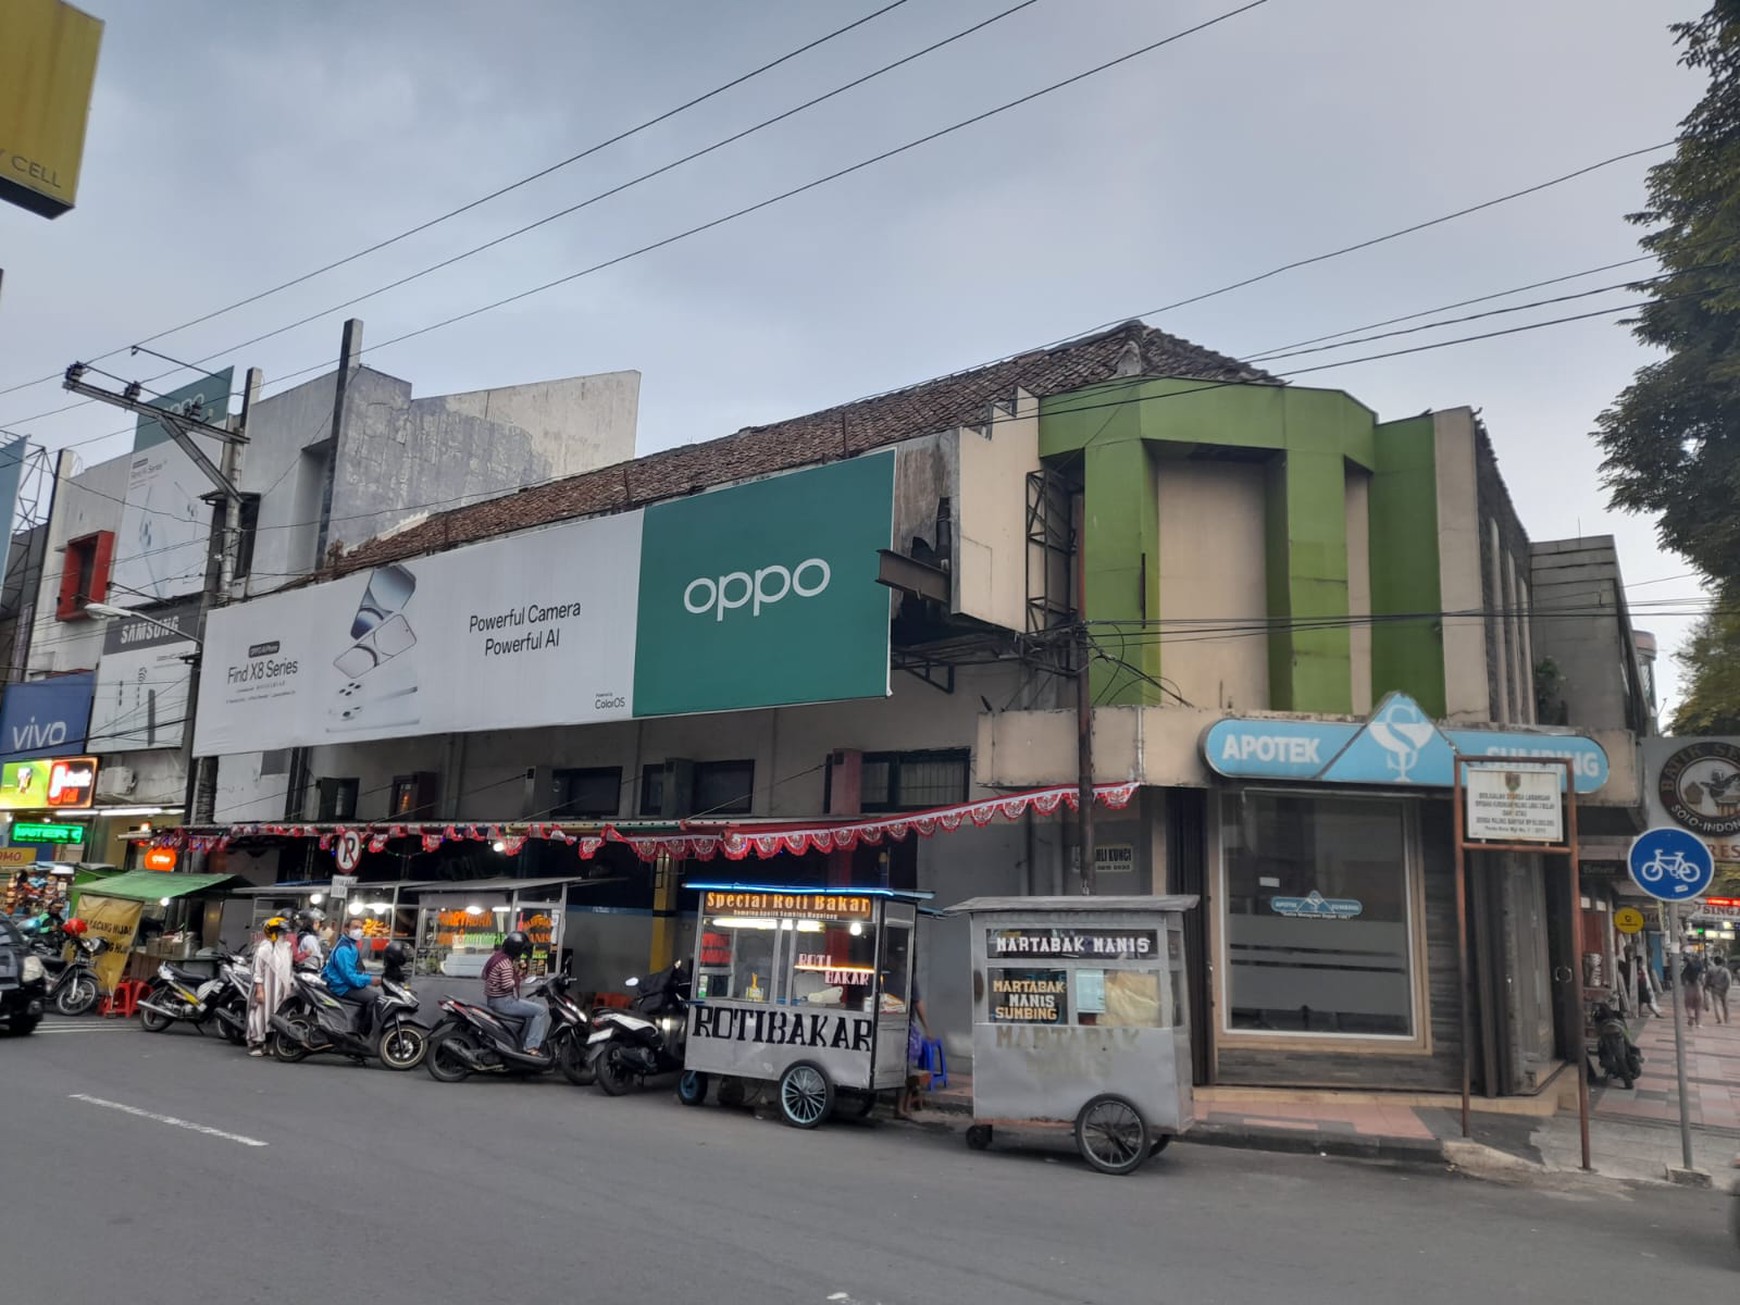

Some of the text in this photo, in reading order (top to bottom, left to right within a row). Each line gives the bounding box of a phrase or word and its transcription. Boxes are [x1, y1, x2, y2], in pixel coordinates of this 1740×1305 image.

[11, 156, 61, 188] CELL
[684, 558, 831, 622] oppo
[120, 616, 180, 644] SAMSUNG
[469, 602, 582, 633] Powerful Camera
[485, 628, 560, 656] Powerful AI
[227, 657, 298, 685] Find X8 Series
[595, 697, 625, 709] ColorOS
[13, 716, 67, 750] vivo
[1222, 735, 1321, 764] APOTEK
[707, 892, 871, 914] Special Roti Bakar
[996, 937, 1151, 953] MARTABAK MANIS
[825, 971, 870, 986] BAKAR
[993, 980, 1065, 994] MARTABAK
[995, 1007, 1058, 1021] SUMBING
[1008, 994, 1055, 1008] MANIS
